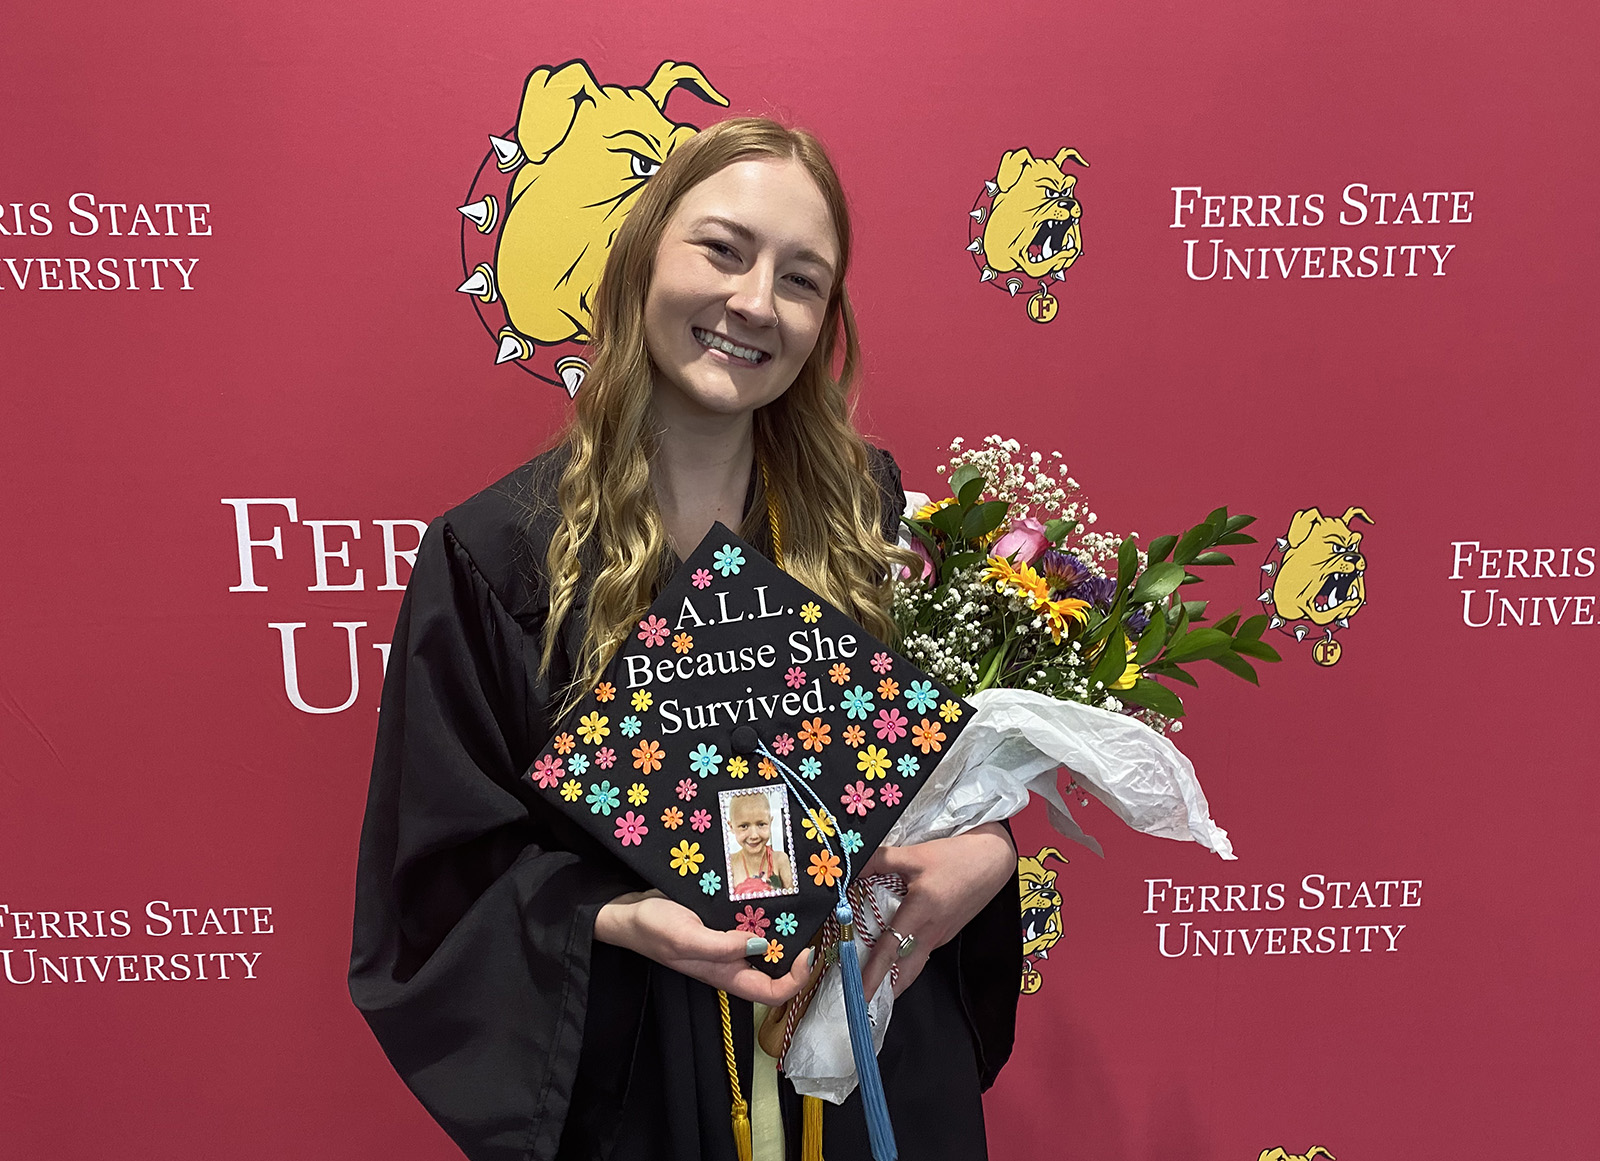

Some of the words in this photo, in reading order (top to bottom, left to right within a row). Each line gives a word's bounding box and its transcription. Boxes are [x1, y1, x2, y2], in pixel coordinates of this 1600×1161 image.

[68, 192, 213, 236] STATE
[1169, 186, 1325, 228] FERRIS
[1339, 183, 1474, 226] STATE
[1183, 239, 1456, 281] UNIVERSITY
[1036, 298, 1054, 319] F
[1448, 541, 1596, 579] FERRIS
[673, 585, 794, 631] A.L.L.
[1460, 589, 1600, 628] UNIVE
[267, 621, 392, 714] U
[622, 643, 776, 689] Because
[788, 627, 858, 665] She
[1321, 643, 1337, 662] F
[658, 677, 836, 736] Survived.
[1142, 877, 1285, 914] FERRIS
[1299, 874, 1423, 912] STATE
[145, 900, 274, 938] STATE
[1155, 922, 1407, 958] UNIVERSITY
[0, 949, 262, 985] UNIVERSITY
